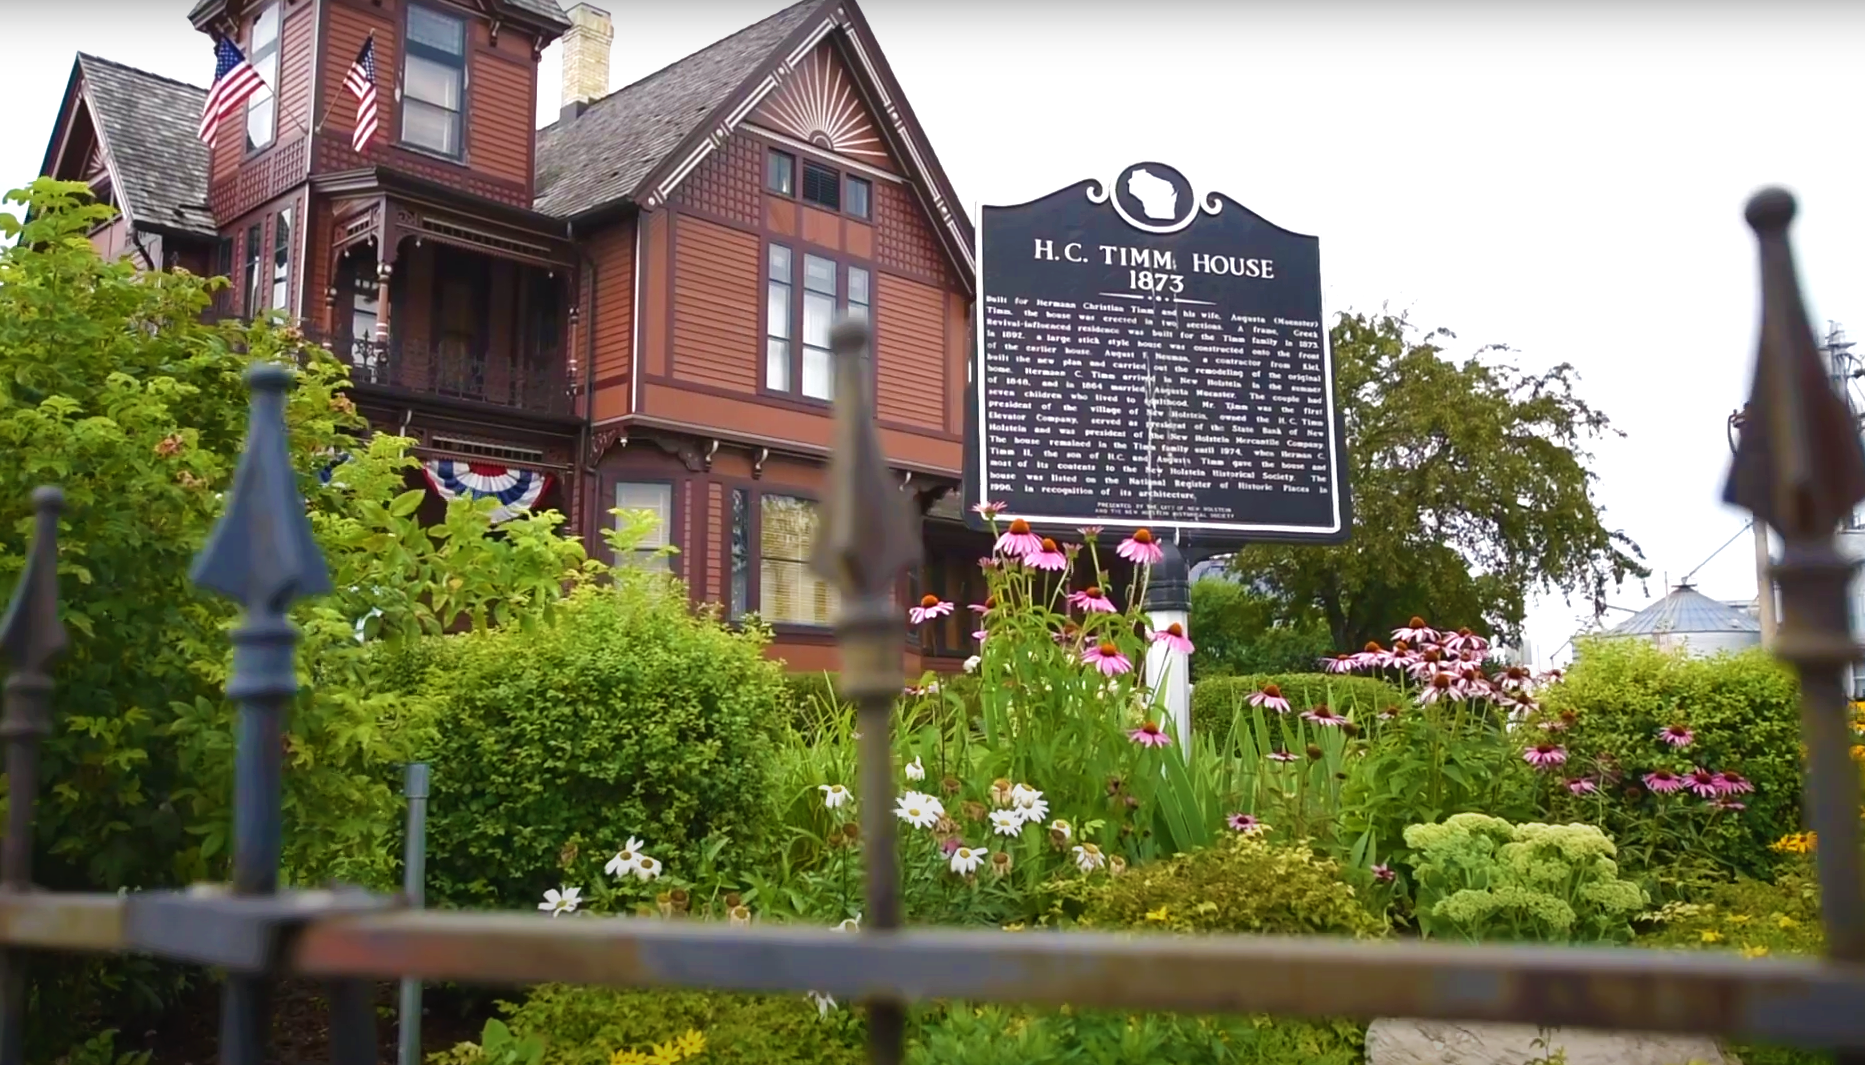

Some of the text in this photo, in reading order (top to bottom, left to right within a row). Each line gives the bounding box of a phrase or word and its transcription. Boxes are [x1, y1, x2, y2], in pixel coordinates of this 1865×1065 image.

[1099, 245, 1172, 270] TIMM
[1192, 253, 1275, 279] HOUSE
[1130, 270, 1185, 294] 1873
[985, 295, 1007, 304] Built
[1015, 297, 1029, 306] for
[1083, 302, 1124, 313] Christian
[1131, 306, 1155, 315] Timm
[1183, 310, 1196, 319] his
[1231, 314, 1266, 325] Augusta
[1024, 309, 1038, 318] the
[1046, 311, 1071, 320] house
[1079, 314, 1095, 322] was
[1103, 315, 1137, 325] erected
[1145, 318, 1153, 326] in
[1293, 329, 1318, 339] Greek
[1078, 324, 1119, 335] residence
[1152, 329, 1173, 338] built
[1180, 332, 1194, 340] for
[1201, 333, 1215, 342] the
[1223, 335, 1245, 344] Timm
[1252, 337, 1278, 347] family
[1285, 339, 1293, 347] in
[987, 341, 997, 350] of
[1004, 342, 1018, 351] the
[1104, 349, 1134, 360] August
[1215, 357, 1261, 367] contractor
[1270, 361, 1291, 369] from
[1047, 333, 1071, 344] large
[1078, 336, 1100, 345] stick
[1108, 338, 1129, 348] style
[1137, 340, 1162, 349] house
[1193, 344, 1244, 355] constructed
[1252, 348, 1270, 357] onto
[1277, 350, 1290, 358] the
[1298, 351, 1319, 360] front
[987, 353, 1321, 384] built the new plan and out the remodeling of the original
[987, 376, 1322, 404] of and in The couple had
[1091, 371, 1116, 380] Timm
[1163, 376, 1172, 384] in
[1180, 377, 1198, 386] New
[1207, 379, 1242, 389] Holstein
[1252, 382, 1260, 390] in
[1269, 383, 1282, 391] the
[988, 389, 1015, 397] seven
[1024, 390, 1062, 400] children
[1071, 393, 1088, 401] who
[1095, 394, 1118, 403] lived
[1126, 396, 1136, 404] to
[1281, 406, 1294, 414] the
[1303, 407, 1323, 415] first
[988, 400, 1324, 427] president of the village of owned the Timm
[989, 424, 1279, 447] Holstein and was president of Holstein Mercantile
[1091, 417, 1121, 426] served
[1194, 423, 1204, 431] of
[1232, 425, 1254, 434] State
[1289, 428, 1298, 436] of
[1307, 429, 1324, 438] New
[989, 435, 1006, 444] The
[1014, 437, 1040, 446] house
[1049, 438, 1091, 448] remained
[1099, 441, 1107, 449] in
[1113, 442, 1127, 450] the
[1161, 444, 1189, 454] family
[1254, 449, 1275, 458] when
[990, 447, 1015, 456] Timm
[1043, 450, 1058, 458] the
[1066, 452, 1082, 460] son
[1089, 452, 1099, 460] of
[1200, 458, 1224, 467] Timm
[1232, 460, 1252, 469] gave
[1262, 461, 1275, 469] the
[1281, 462, 1305, 470] house
[1312, 463, 1326, 471] and
[990, 459, 1011, 468] most
[1017, 460, 1028, 469] of
[1037, 461, 1049, 470] its
[1106, 464, 1115, 473] to
[1123, 465, 1137, 474] the
[1170, 468, 1206, 477] Holstein
[1212, 470, 1255, 479] Historical
[1311, 474, 1326, 482] The
[990, 471, 1016, 481] house
[1026, 474, 1043, 482] was
[1051, 474, 1077, 483] listed
[1105, 476, 1119, 485] the
[1175, 480, 1212, 490] Register
[1220, 482, 1229, 490] of
[1238, 483, 1272, 492] Historic
[1319, 486, 1328, 494] in
[1024, 485, 1132, 497] in recognition of its
